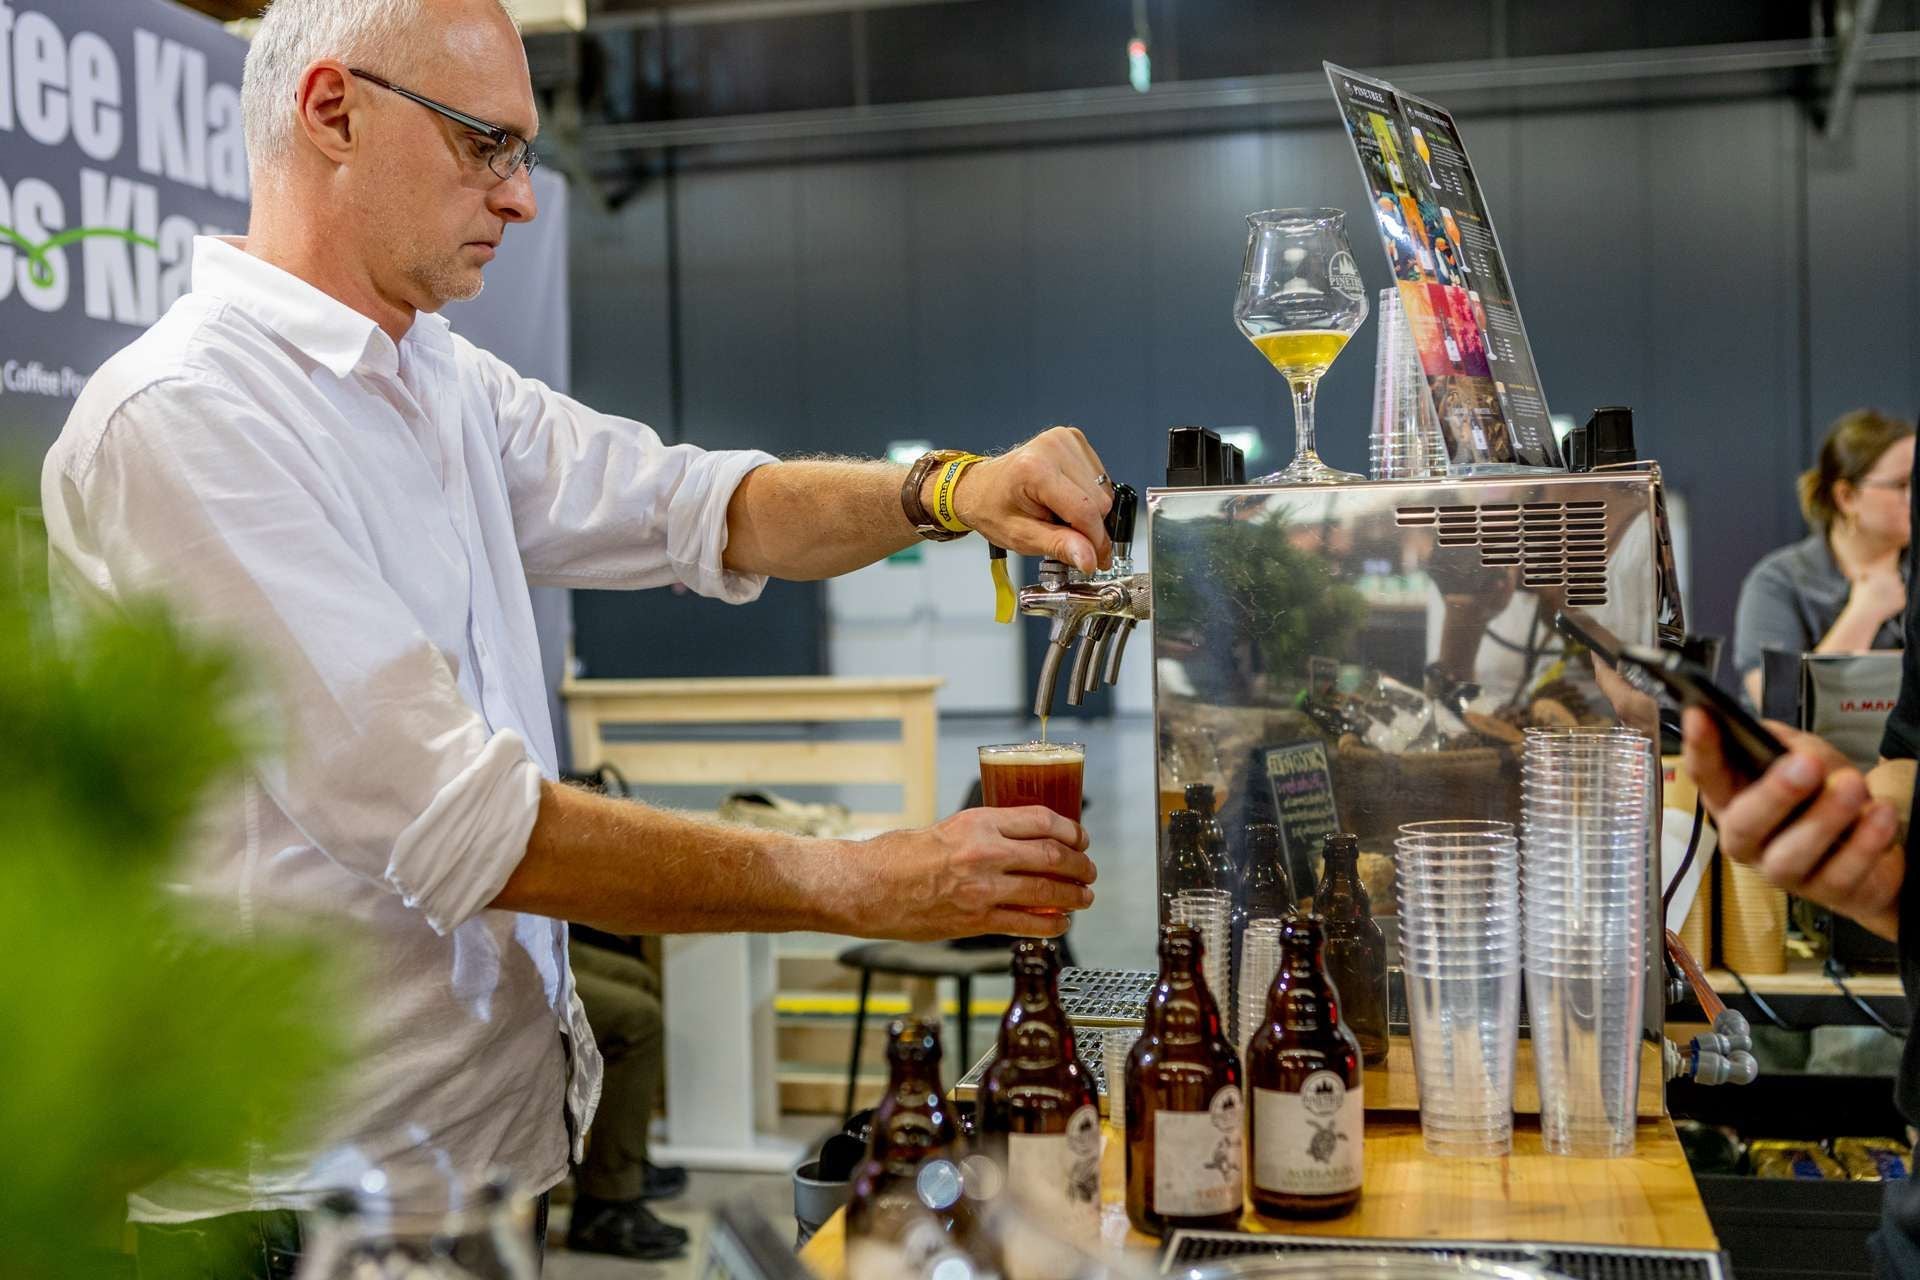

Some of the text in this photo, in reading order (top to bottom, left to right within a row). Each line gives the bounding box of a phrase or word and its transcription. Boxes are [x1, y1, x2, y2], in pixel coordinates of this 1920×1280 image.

[134, 28, 251, 202] Kla
[80, 167, 231, 328] Kla
[4, 359, 60, 397] Coffee
